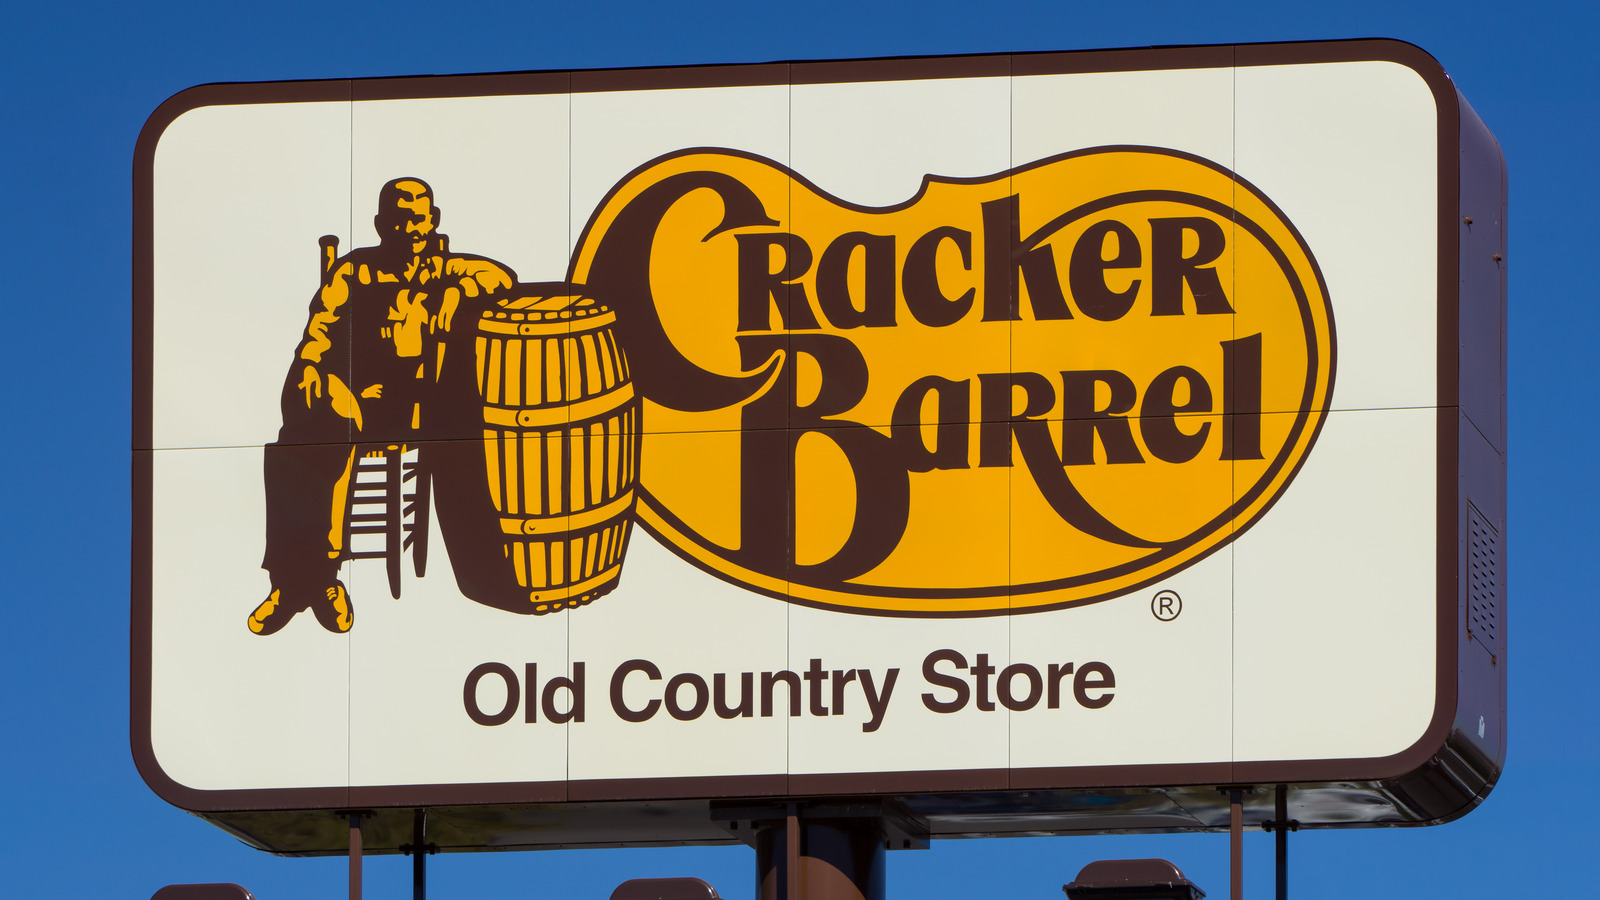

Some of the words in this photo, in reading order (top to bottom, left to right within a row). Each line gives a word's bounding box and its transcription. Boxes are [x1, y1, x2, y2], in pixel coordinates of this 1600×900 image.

[584, 170, 1237, 413] Cracker
[734, 331, 1266, 583] Barrel
[462, 661, 586, 727] Old
[609, 657, 901, 733] Country
[920, 648, 1117, 714] Store
